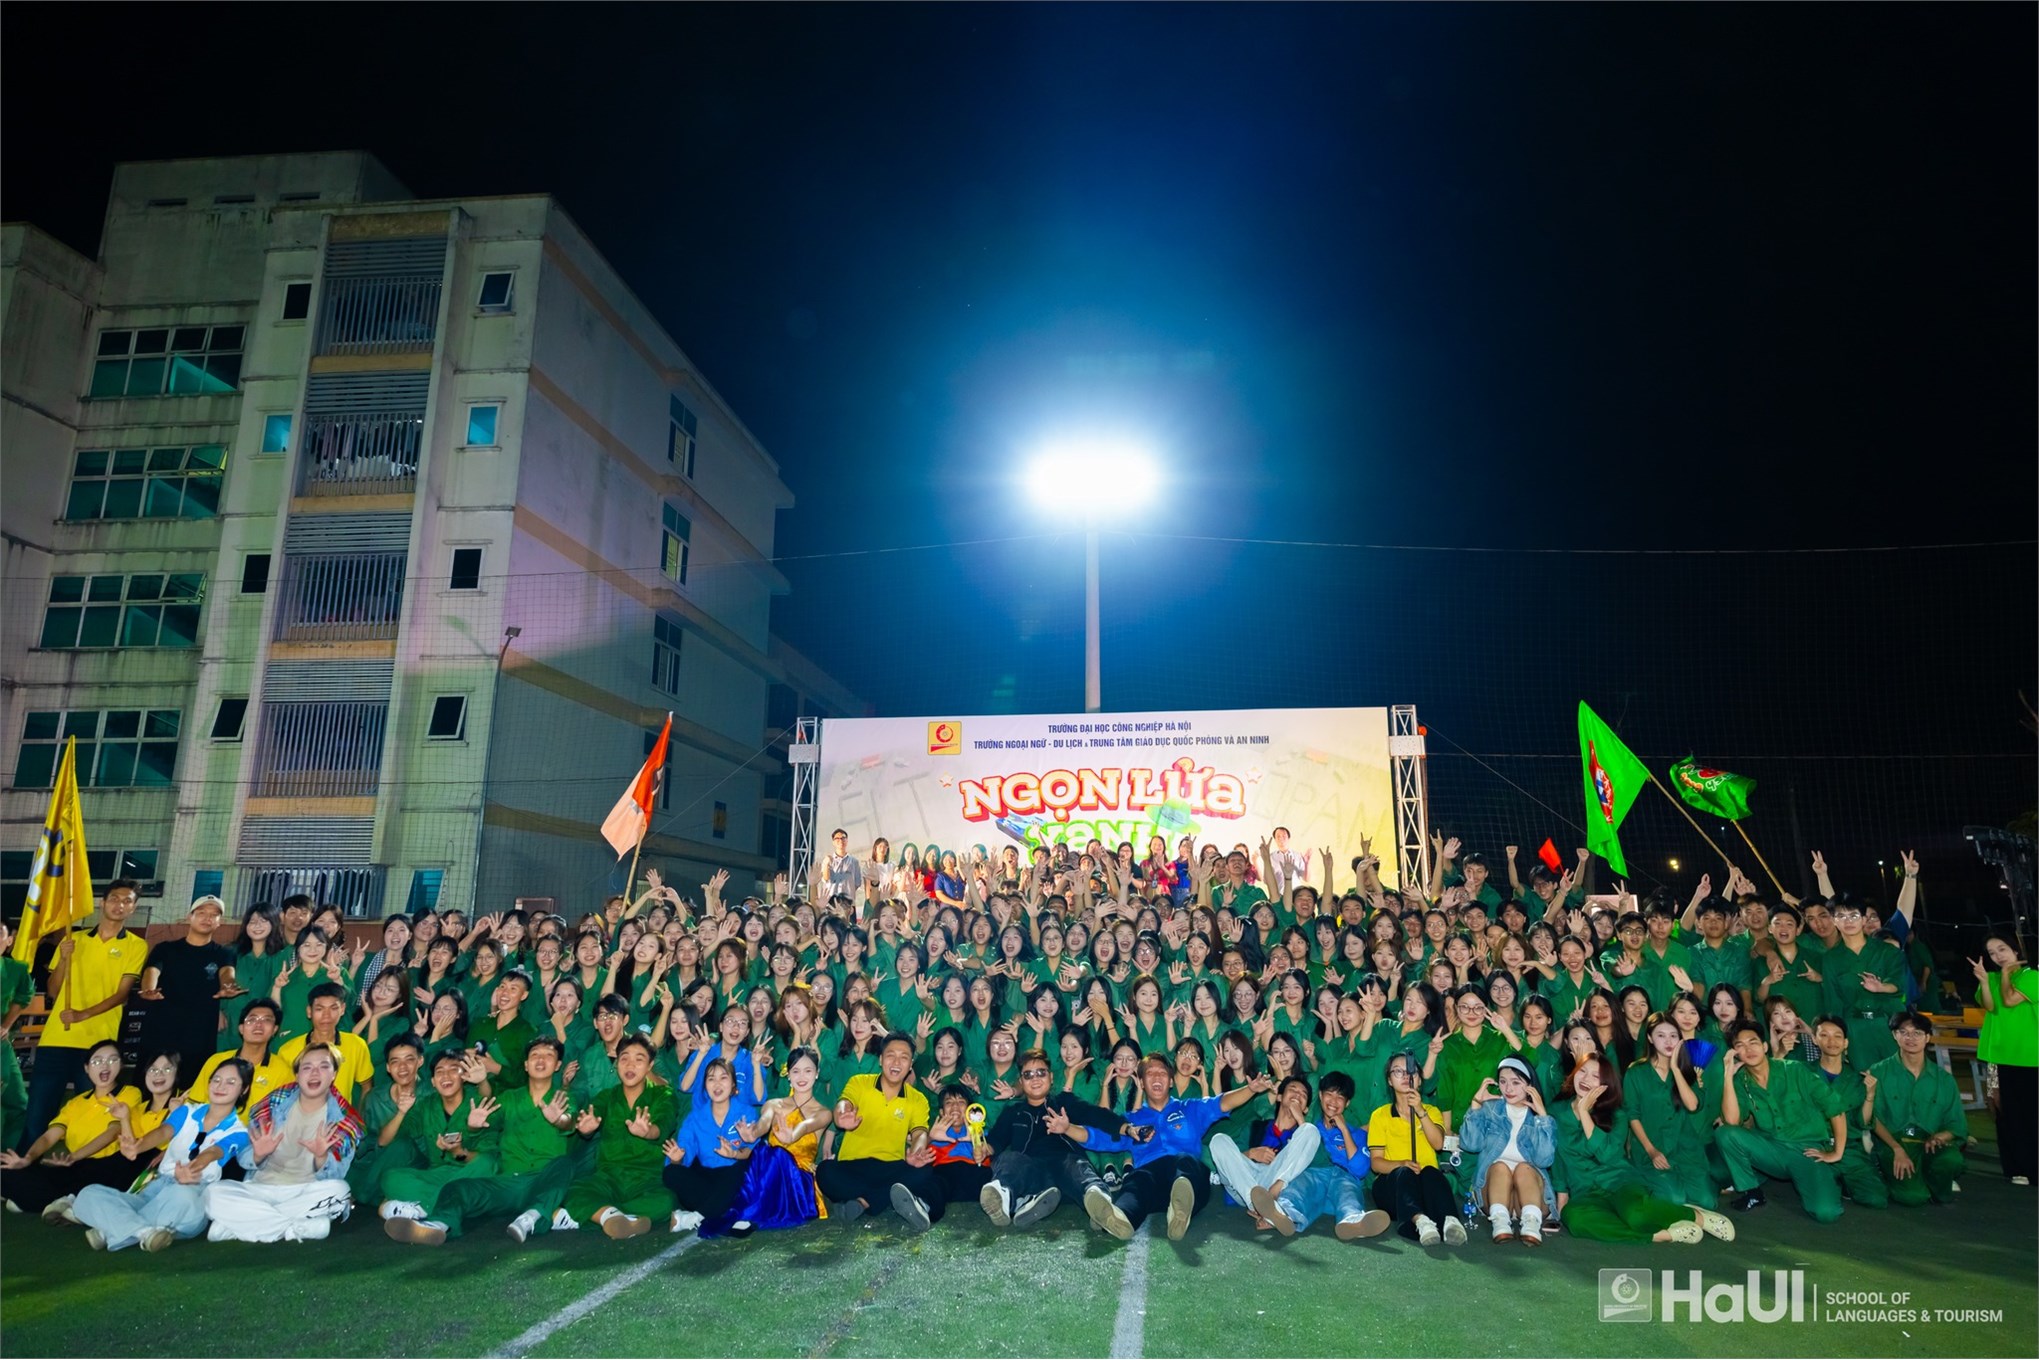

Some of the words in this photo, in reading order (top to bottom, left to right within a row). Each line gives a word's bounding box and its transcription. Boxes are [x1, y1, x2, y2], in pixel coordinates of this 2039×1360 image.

[1048, 722, 1078, 733] TRƯỜNG
[1079, 724, 1093, 735] ĐẠI
[1094, 723, 1110, 735] HỌC
[1112, 722, 1133, 732] CÔNG
[1135, 721, 1163, 733] NGHIỆP
[1165, 721, 1176, 731] HÀ
[1177, 720, 1192, 732] NỘI
[974, 739, 1003, 749] TRƯỜNG
[1005, 740, 1028, 750] NGOẠI
[1030, 738, 1047, 748] NGỮ
[1053, 739, 1064, 748] DU
[1065, 739, 1083, 749] LỊCH
[1089, 739, 1115, 747] TRUNG
[1116, 736, 1133, 747] TÂM
[1135, 736, 1153, 746] GIÁO
[1155, 737, 1171, 748] DỤC
[1172, 734, 1194, 746] QUỐC
[1195, 734, 1222, 745] PHÒNG
[1224, 734, 1235, 744] VÀ
[1236, 735, 1248, 744] AN
[1249, 735, 1270, 744] NINH
[959, 768, 1122, 822] NGỌN
